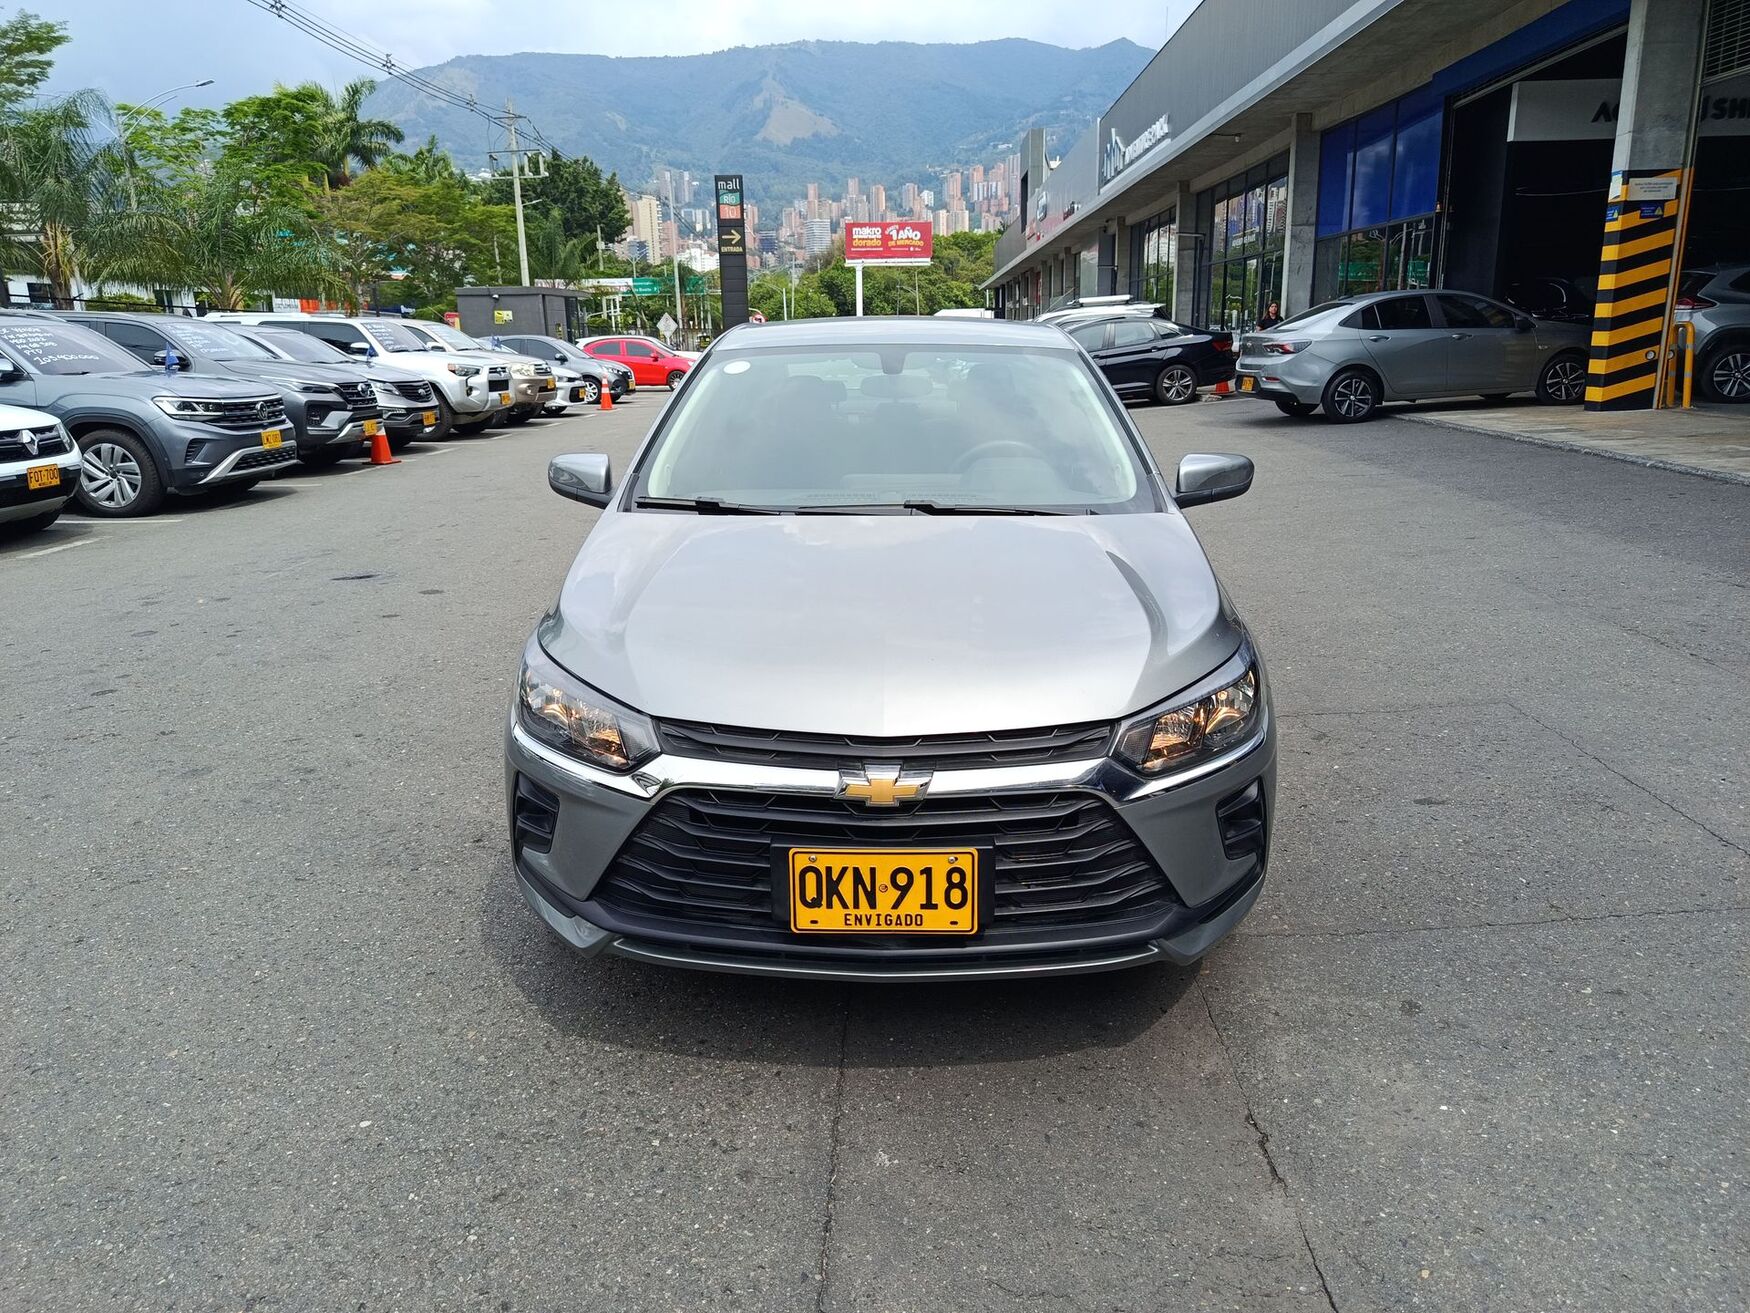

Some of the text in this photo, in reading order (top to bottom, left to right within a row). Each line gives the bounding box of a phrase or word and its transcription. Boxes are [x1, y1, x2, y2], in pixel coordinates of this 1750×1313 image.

[717, 178, 740, 190] mall
[725, 207, 737, 218] 10
[852, 226, 882, 235] makro
[889, 229, 898, 240] 1
[898, 226, 921, 240] AÑO
[852, 238, 882, 247] dorado
[896, 239, 924, 247] MERCADO
[844, 913, 924, 927] ENVIGADO
